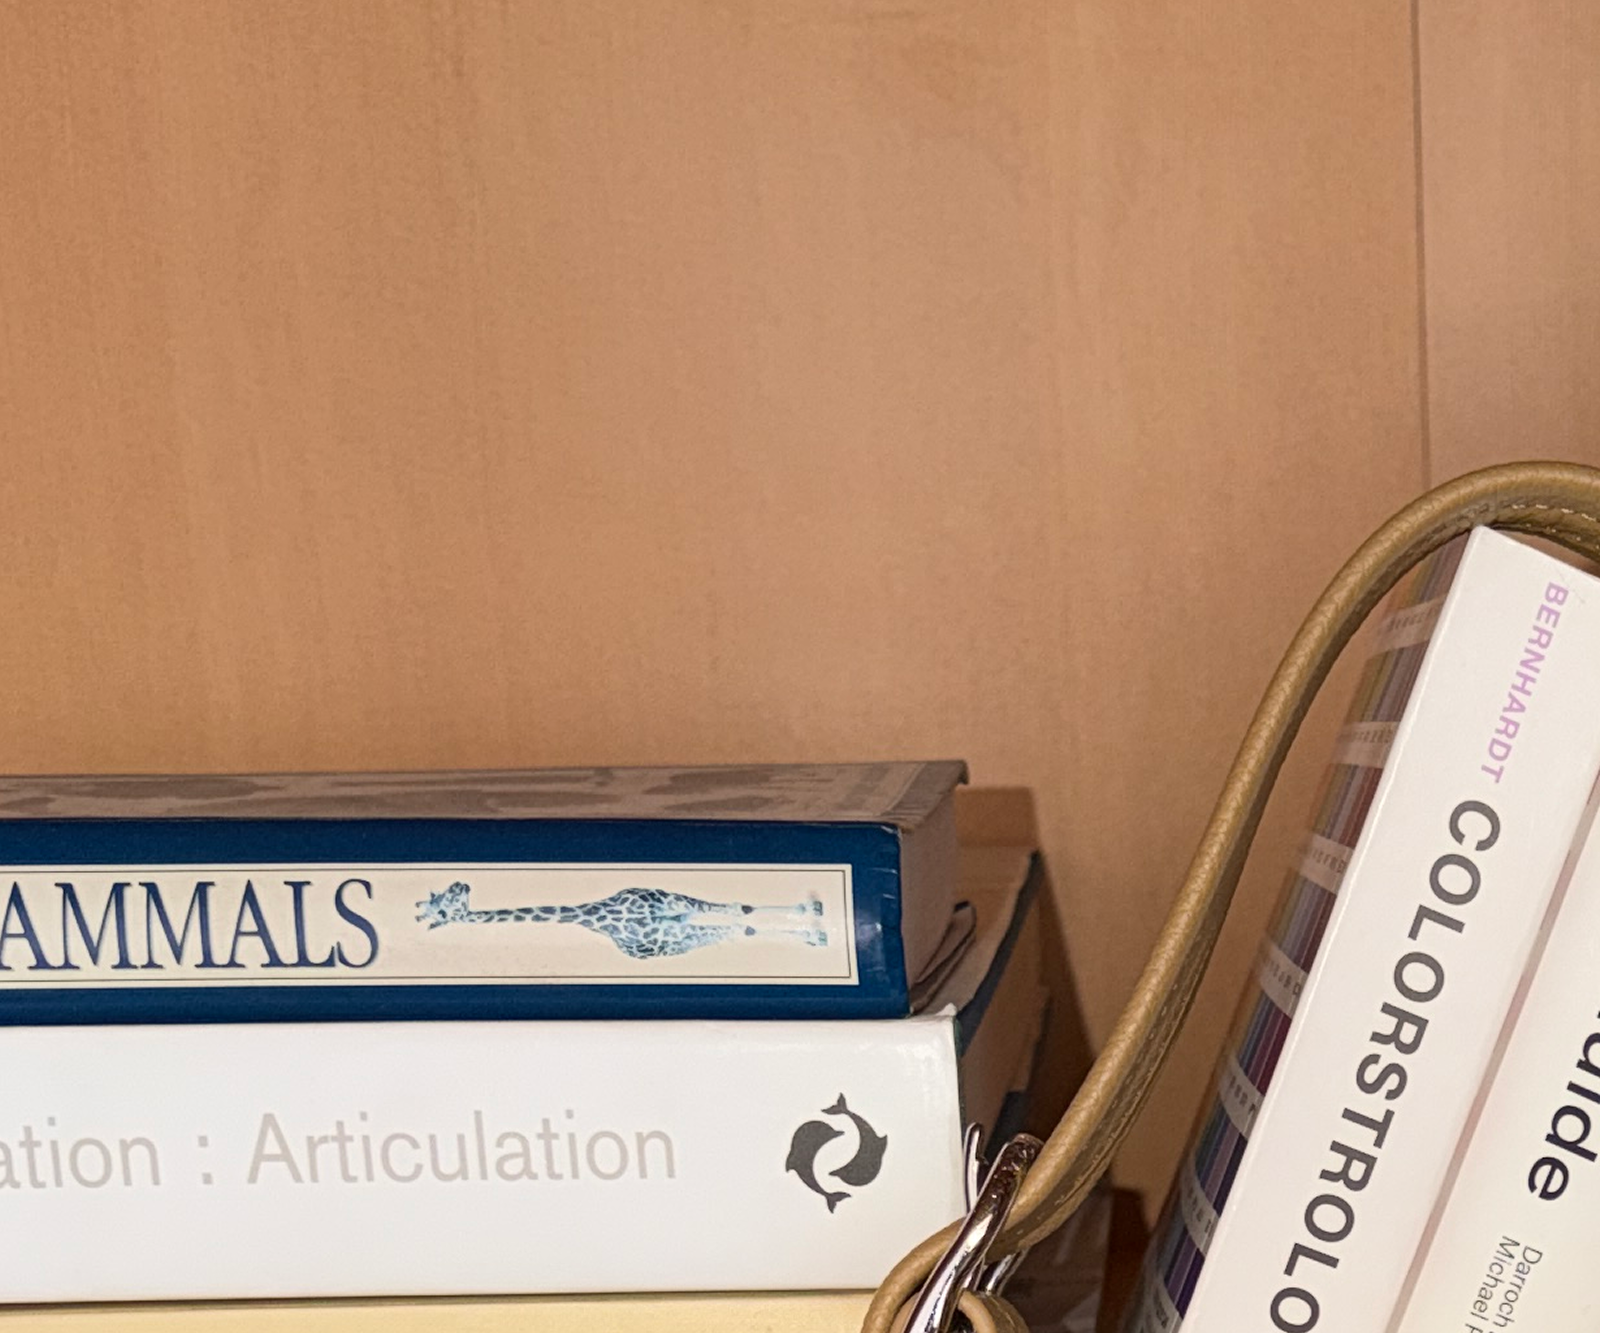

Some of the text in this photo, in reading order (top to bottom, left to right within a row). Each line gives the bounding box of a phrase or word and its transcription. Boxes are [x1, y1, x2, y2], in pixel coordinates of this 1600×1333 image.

[1481, 581, 1569, 783] BERNHARDT
[247, 1110, 677, 1188] Articulation
[1470, 1236, 1520, 1322] Michael
[1497, 1245, 1543, 1328] Darroch
